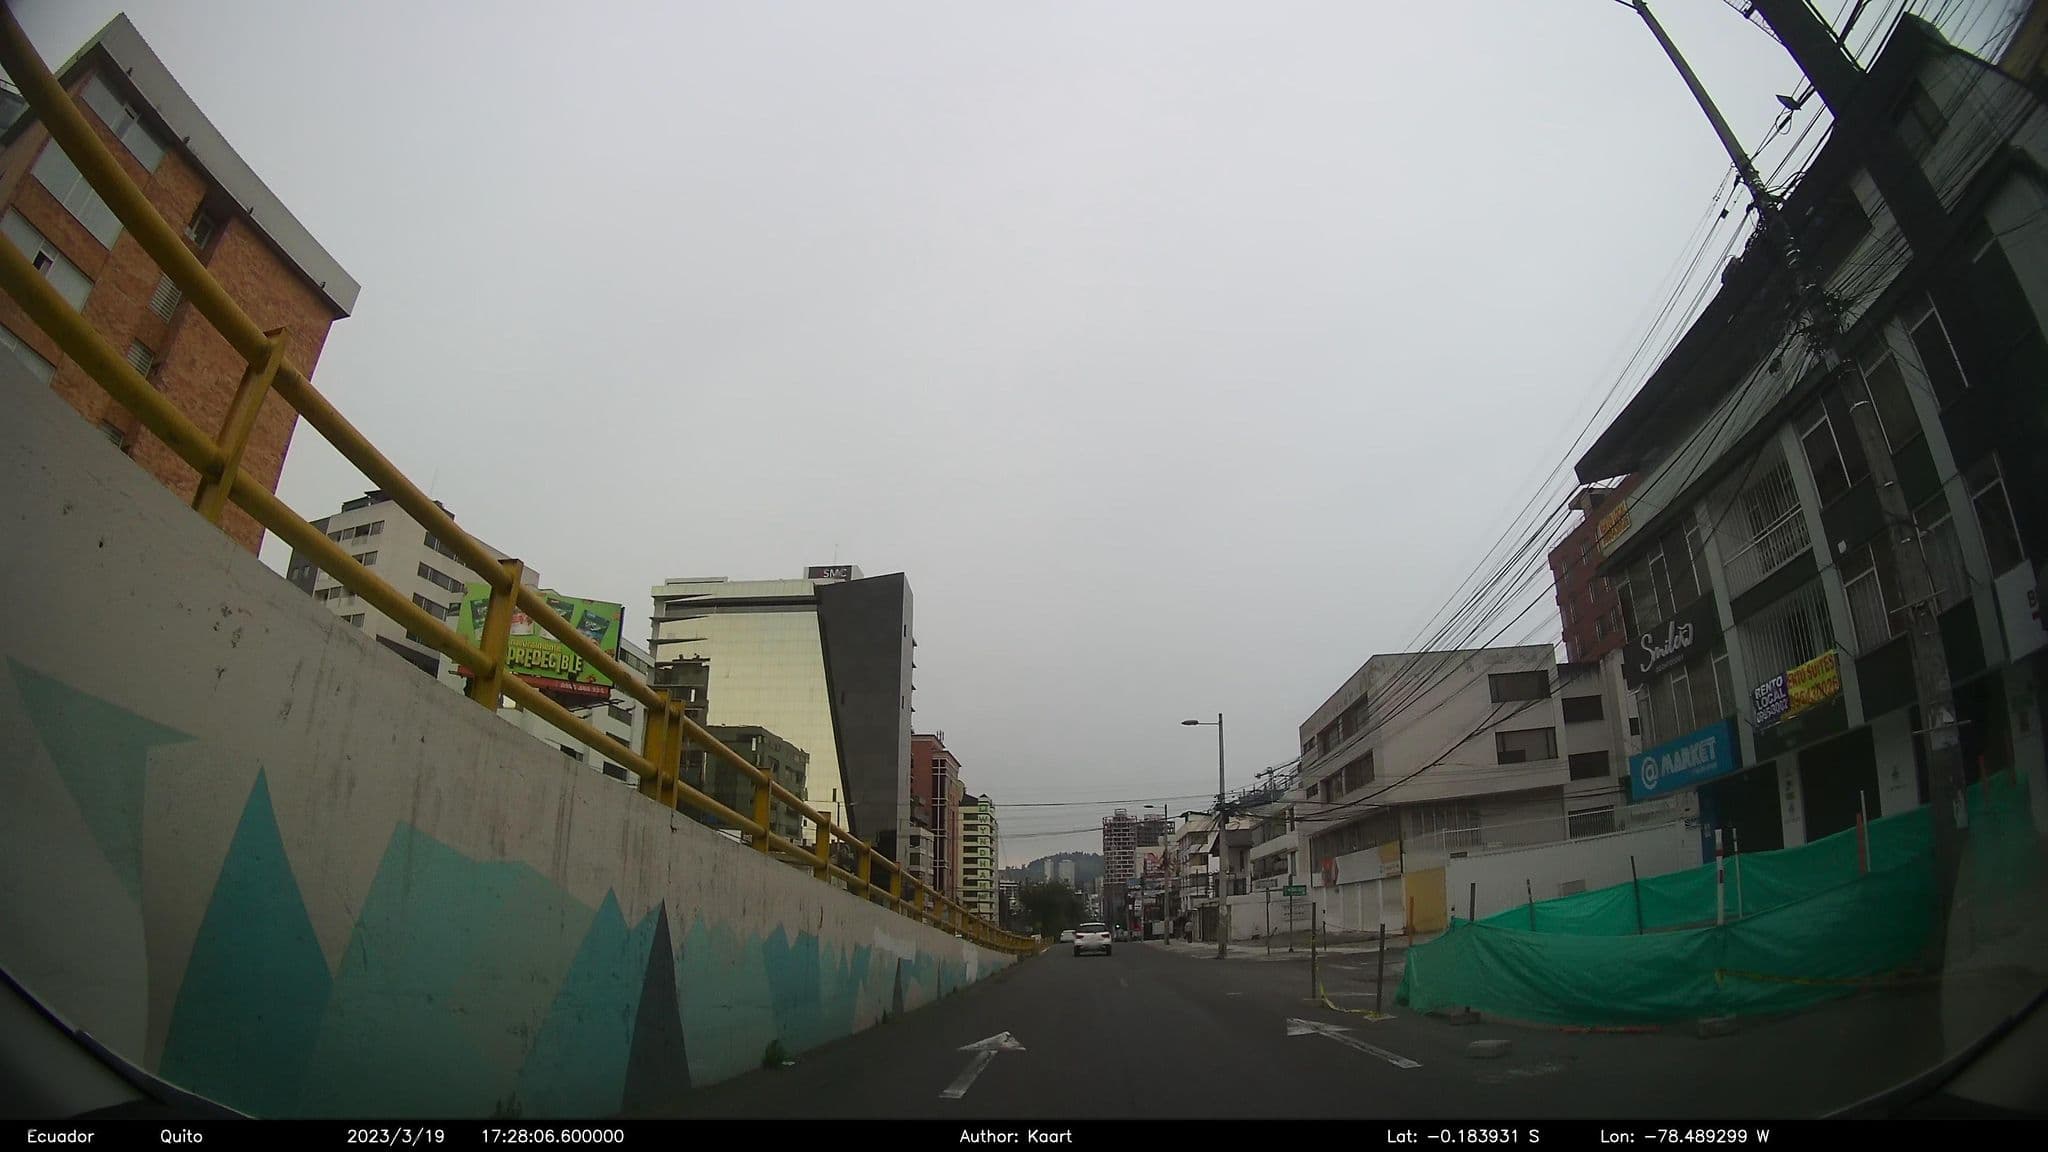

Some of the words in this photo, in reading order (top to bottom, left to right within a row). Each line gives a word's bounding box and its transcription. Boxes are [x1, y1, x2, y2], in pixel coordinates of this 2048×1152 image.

[1754, 676, 1783, 700] RENTO
[1756, 688, 1787, 710] LOCAL
[1661, 736, 1717, 776] MARKET
